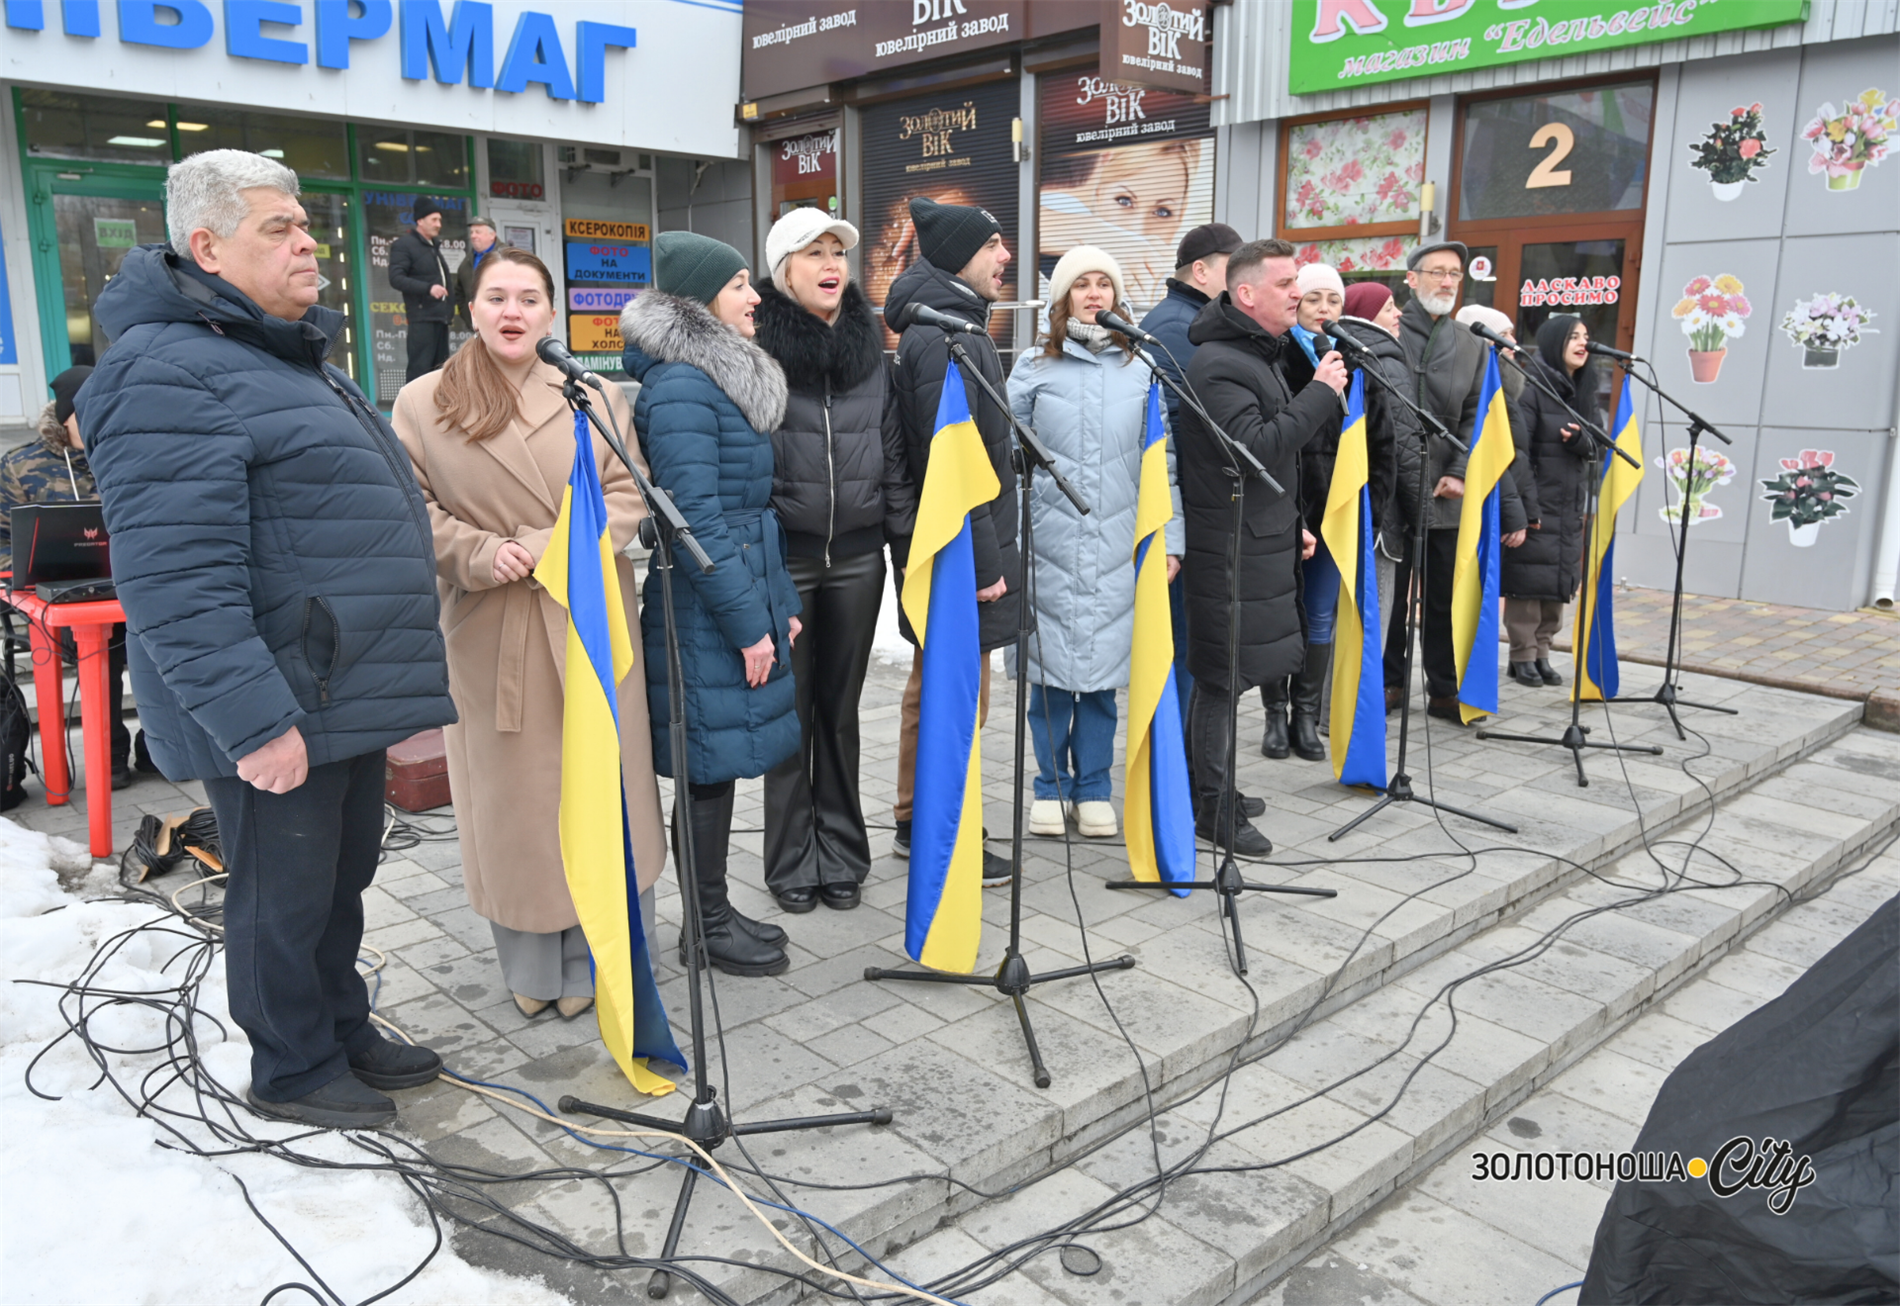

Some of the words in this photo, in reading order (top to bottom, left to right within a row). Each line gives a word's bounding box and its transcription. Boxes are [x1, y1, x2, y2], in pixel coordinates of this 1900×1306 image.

[752, 16, 817, 49] ювелірний
[819, 9, 857, 32] завод
[875, 21, 958, 57] ювелірний
[961, 13, 1009, 38] завод
[1337, 37, 1472, 79] магазин
[1122, 54, 1175, 72] ювелірний
[1176, 64, 1203, 79] завод
[1076, 123, 1138, 143] ювелірний
[1140, 120, 1176, 133] завод
[1525, 122, 1576, 189] 2
[491, 181, 543, 198] ФОТО
[100, 227, 134, 240] ВХІД
[569, 221, 646, 239] КСЕРОКОПІЯ
[371, 246, 389, 256] Сб.
[589, 246, 629, 257] ФОТО
[601, 259, 618, 268] НА
[574, 270, 646, 281] ДОКУМЕНТИ
[1521, 276, 1621, 293] ЛАСКАВО
[1520, 291, 1618, 307] ПРОСИМО
[604, 328, 621, 338] НА
[377, 341, 395, 350] Сб.
[592, 340, 625, 350] ХОЛС
[377, 353, 396, 363] Нд.
